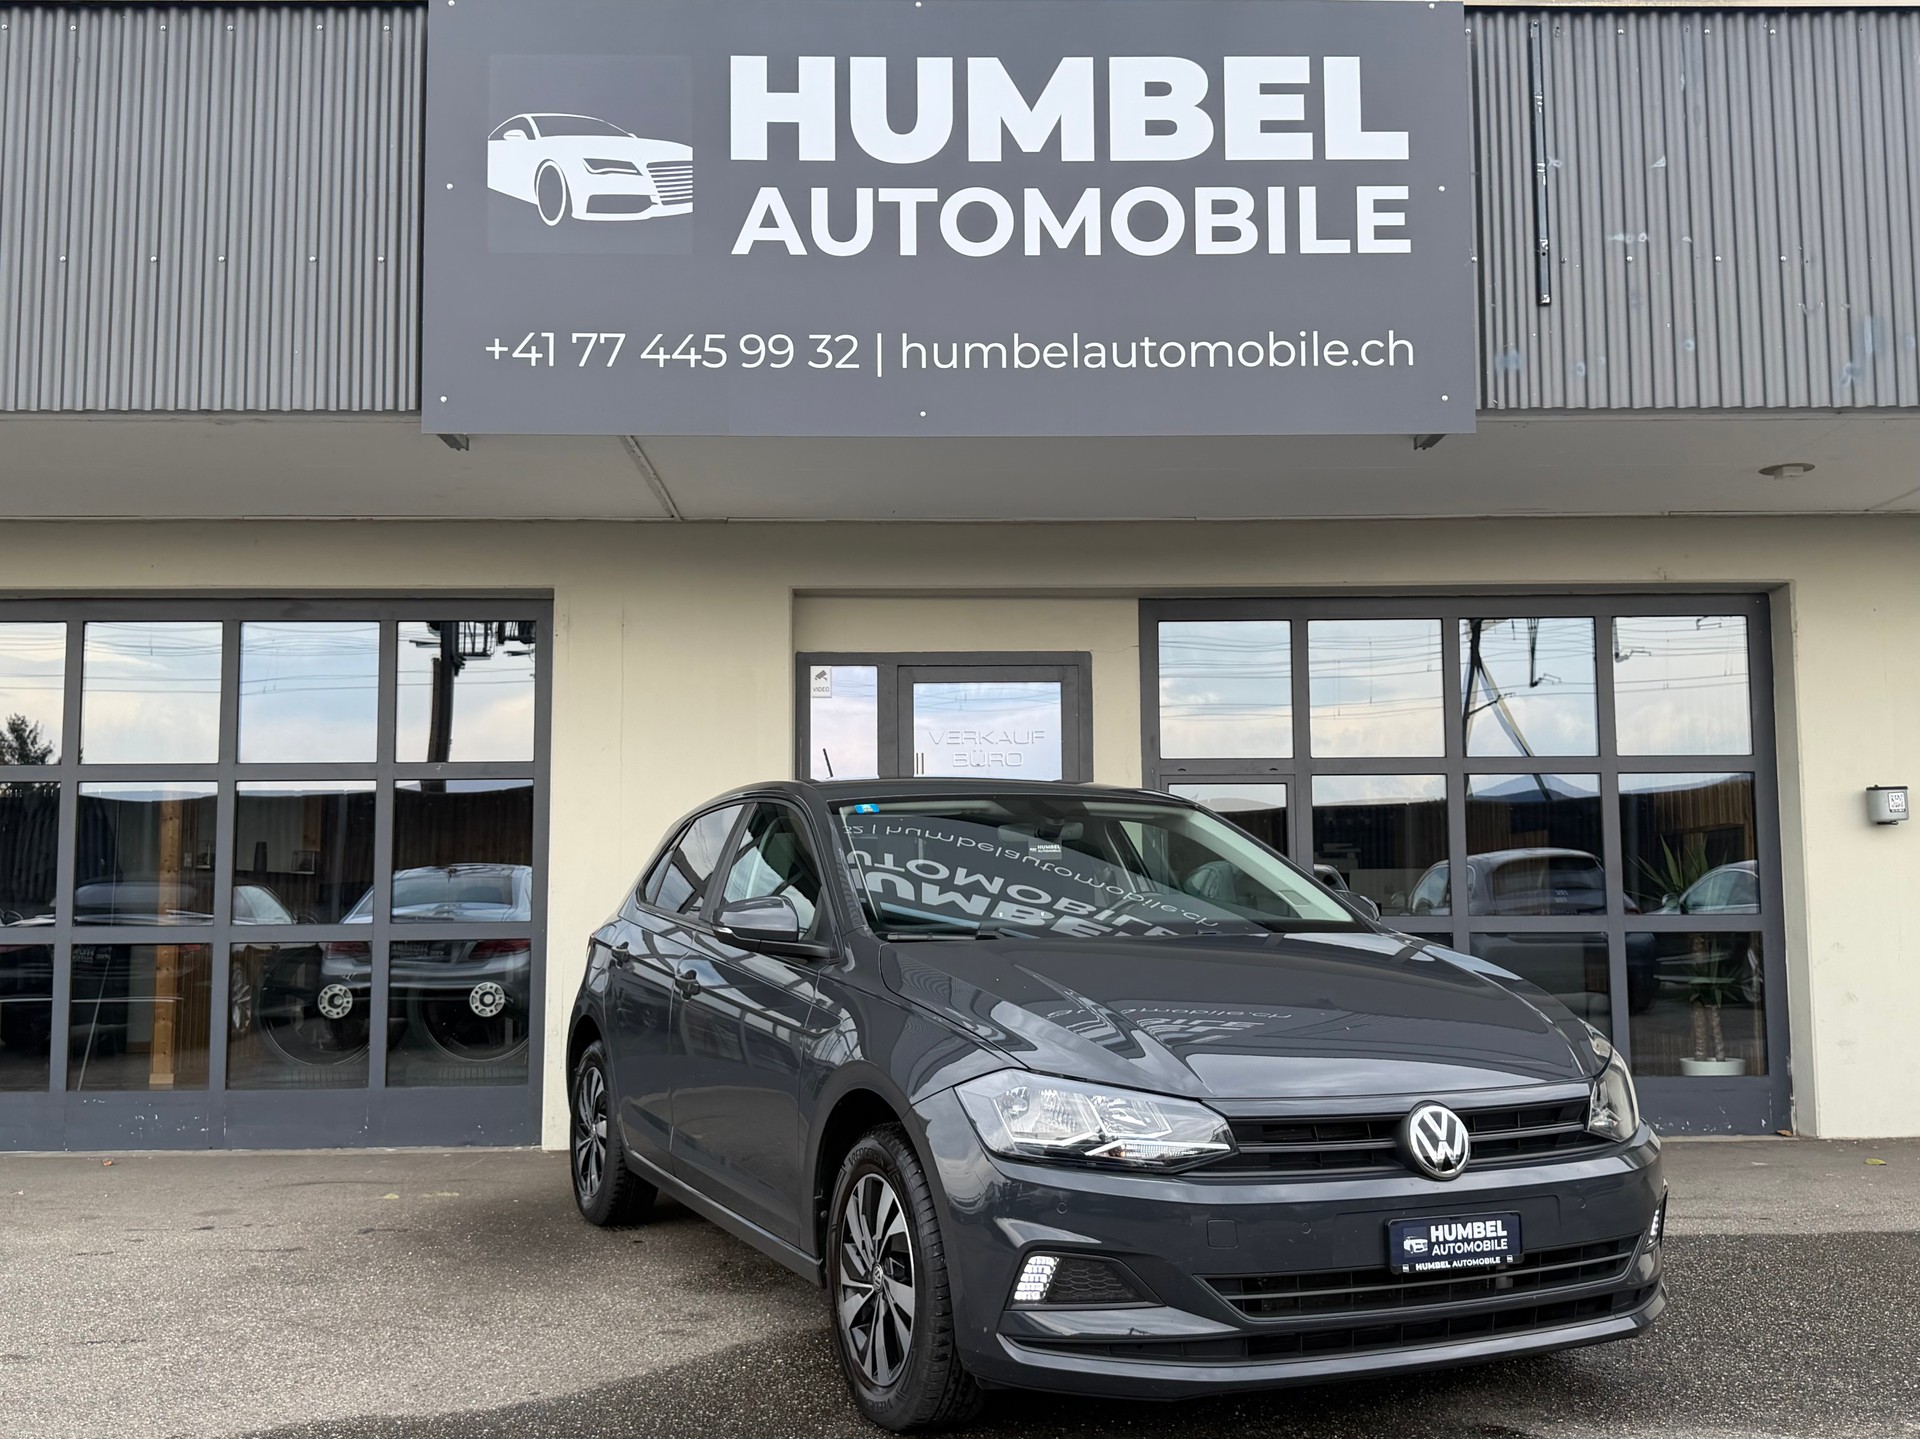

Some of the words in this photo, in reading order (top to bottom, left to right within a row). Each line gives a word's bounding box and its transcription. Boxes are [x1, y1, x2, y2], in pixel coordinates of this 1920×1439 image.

[730, 55, 1410, 164] HUMBEL
[731, 185, 1412, 257] AUTOMOBILE
[485, 332, 555, 367] +41
[571, 332, 626, 368] 77
[640, 333, 727, 369] 445
[739, 333, 795, 369] 99
[807, 334, 860, 369] 32
[902, 329, 1414, 369] humbelautomobile.ch
[929, 730, 1045, 745] VERKAUF
[953, 750, 1023, 767] BÜRO
[1430, 1219, 1508, 1243] HUMBEL
[1431, 1238, 1508, 1256] AUTOMOBILE
[1415, 1261, 1451, 1271] HUMBEL
[1452, 1257, 1501, 1268] AUTOMOBILE
